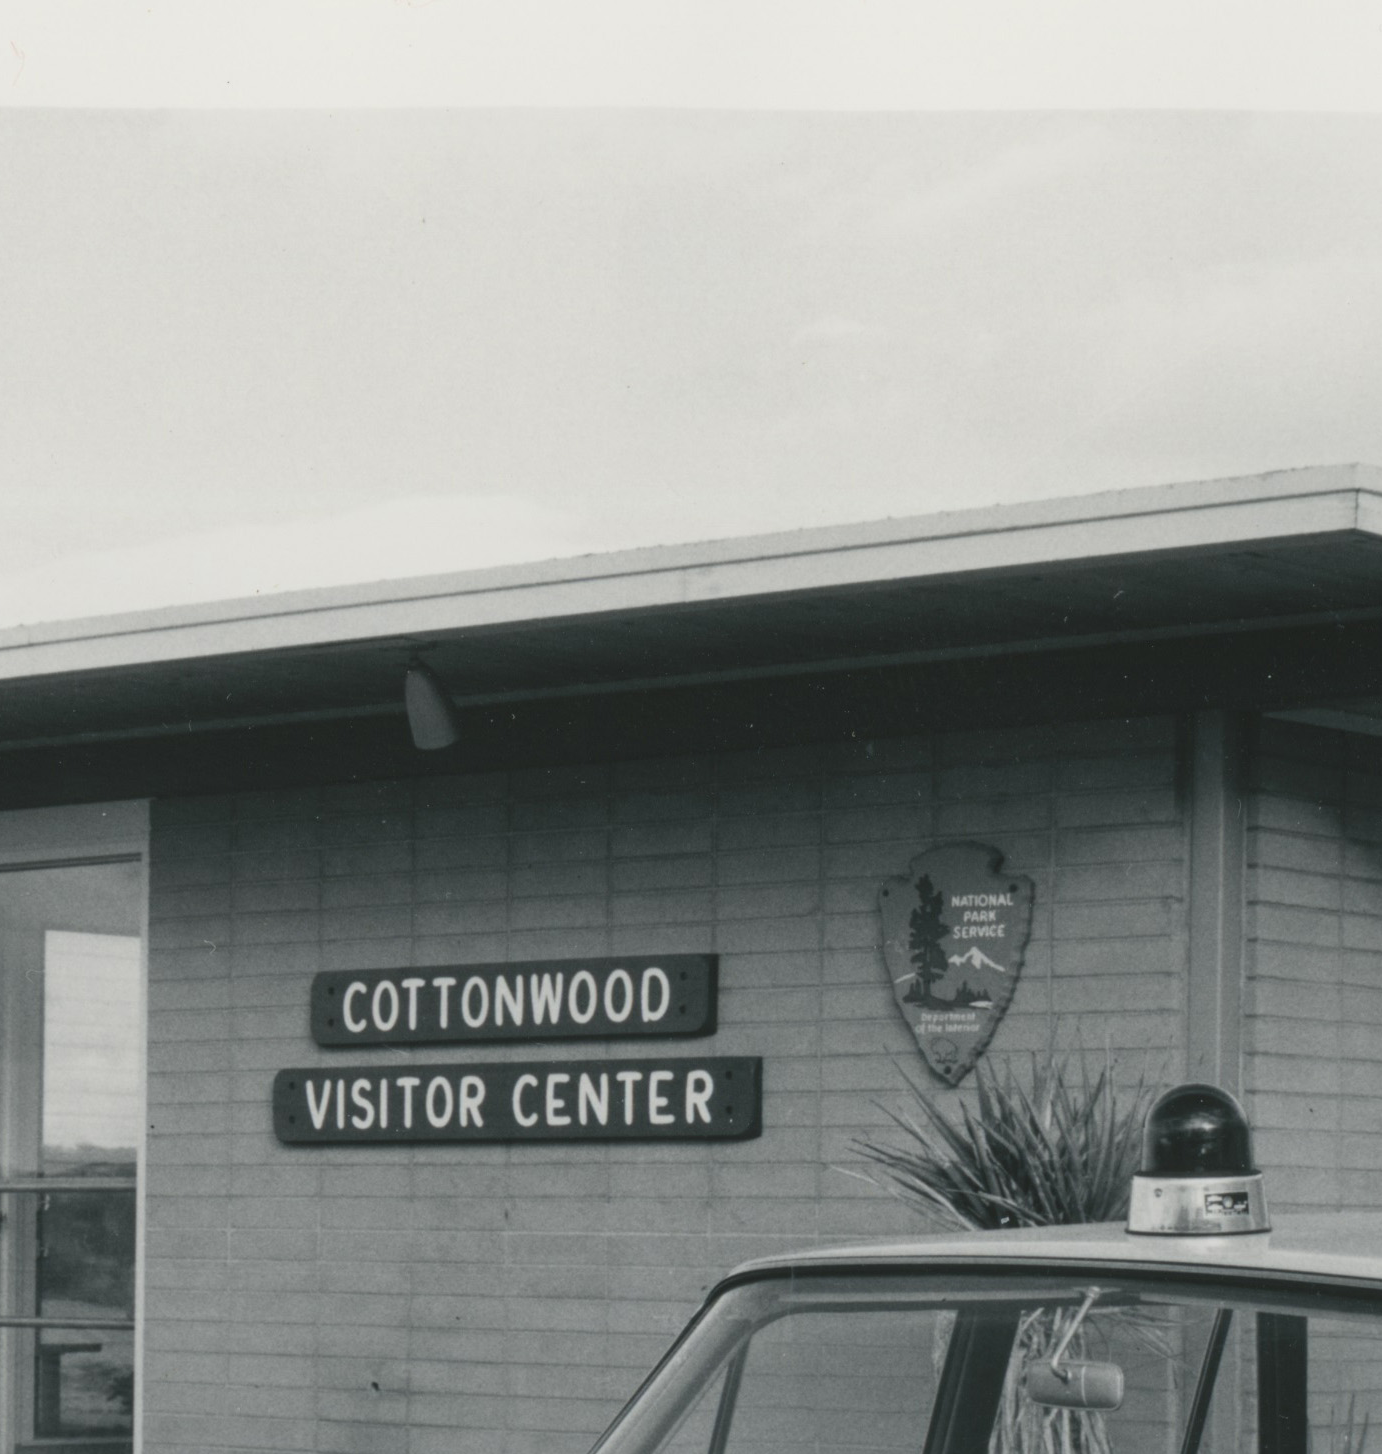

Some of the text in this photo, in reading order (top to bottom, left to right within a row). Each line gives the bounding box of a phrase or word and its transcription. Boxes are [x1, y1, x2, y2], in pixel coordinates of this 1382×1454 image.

[950, 892, 1014, 908] NATIONAL
[963, 909, 997, 922] PARK
[952, 924, 1006, 939] SERVICE
[341, 966, 672, 1034] COTTONWOOD
[304, 1069, 715, 1131] VISITOR CENTER
